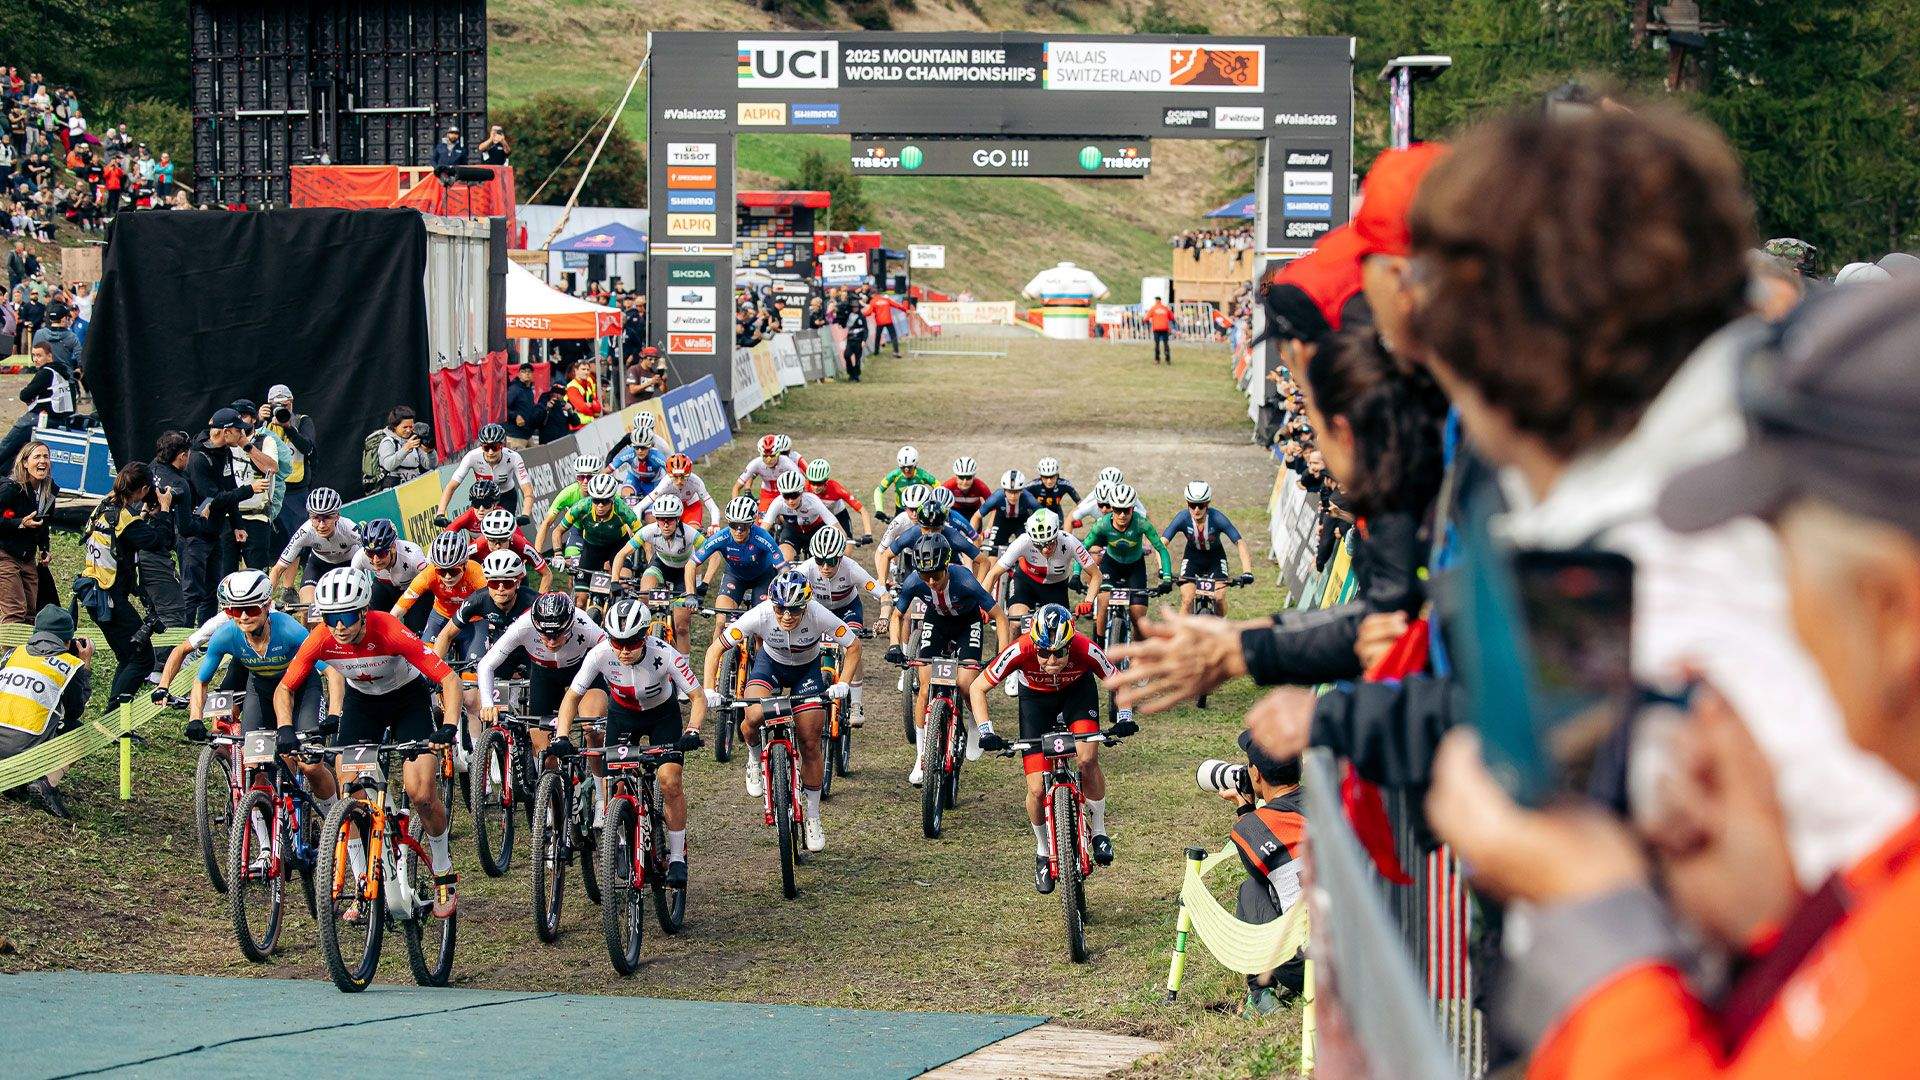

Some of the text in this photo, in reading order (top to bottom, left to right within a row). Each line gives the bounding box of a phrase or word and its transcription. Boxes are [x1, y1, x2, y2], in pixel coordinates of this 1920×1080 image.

[845, 49, 1006, 64] 2025 MOUNTAIN BIKE
[1056, 51, 1107, 64] VALAIS
[755, 50, 828, 79] UCI
[845, 66, 1037, 82] WORLD CHAMPIONSHIPS
[1056, 69, 1162, 83] SWITZERLAND
[664, 109, 727, 120] #Valais2025
[743, 109, 781, 120] ALPIQ
[793, 110, 838, 119] SHIMANO
[1274, 114, 1338, 125] #Valais2025
[851, 156, 899, 168] TISSOT
[972, 149, 1029, 167] GO !!!
[1103, 157, 1151, 169] TISSOT
[670, 197, 714, 206] SHIMANO
[1286, 202, 1330, 211] SHIMANO
[672, 219, 711, 231] ALPIQ
[683, 245, 701, 253] UCI
[830, 263, 856, 273] 25m
[684, 338, 712, 348] Wallis
[668, 389, 726, 452] SHIMANO
[594, 576, 609, 587] 27
[1200, 581, 1212, 591] 19
[653, 592, 666, 600] 14
[1112, 591, 1127, 599] 22
[969, 621, 981, 648] USA
[48, 656, 71, 675] UCI
[240, 655, 287, 664] SWEDEN
[937, 665, 952, 677] 15
[209, 697, 227, 709] 10
[255, 738, 265, 753] 3
[1053, 738, 1065, 753] 8
[354, 747, 367, 761] 7
[617, 746, 629, 760] 9
[1260, 841, 1277, 856] 13
